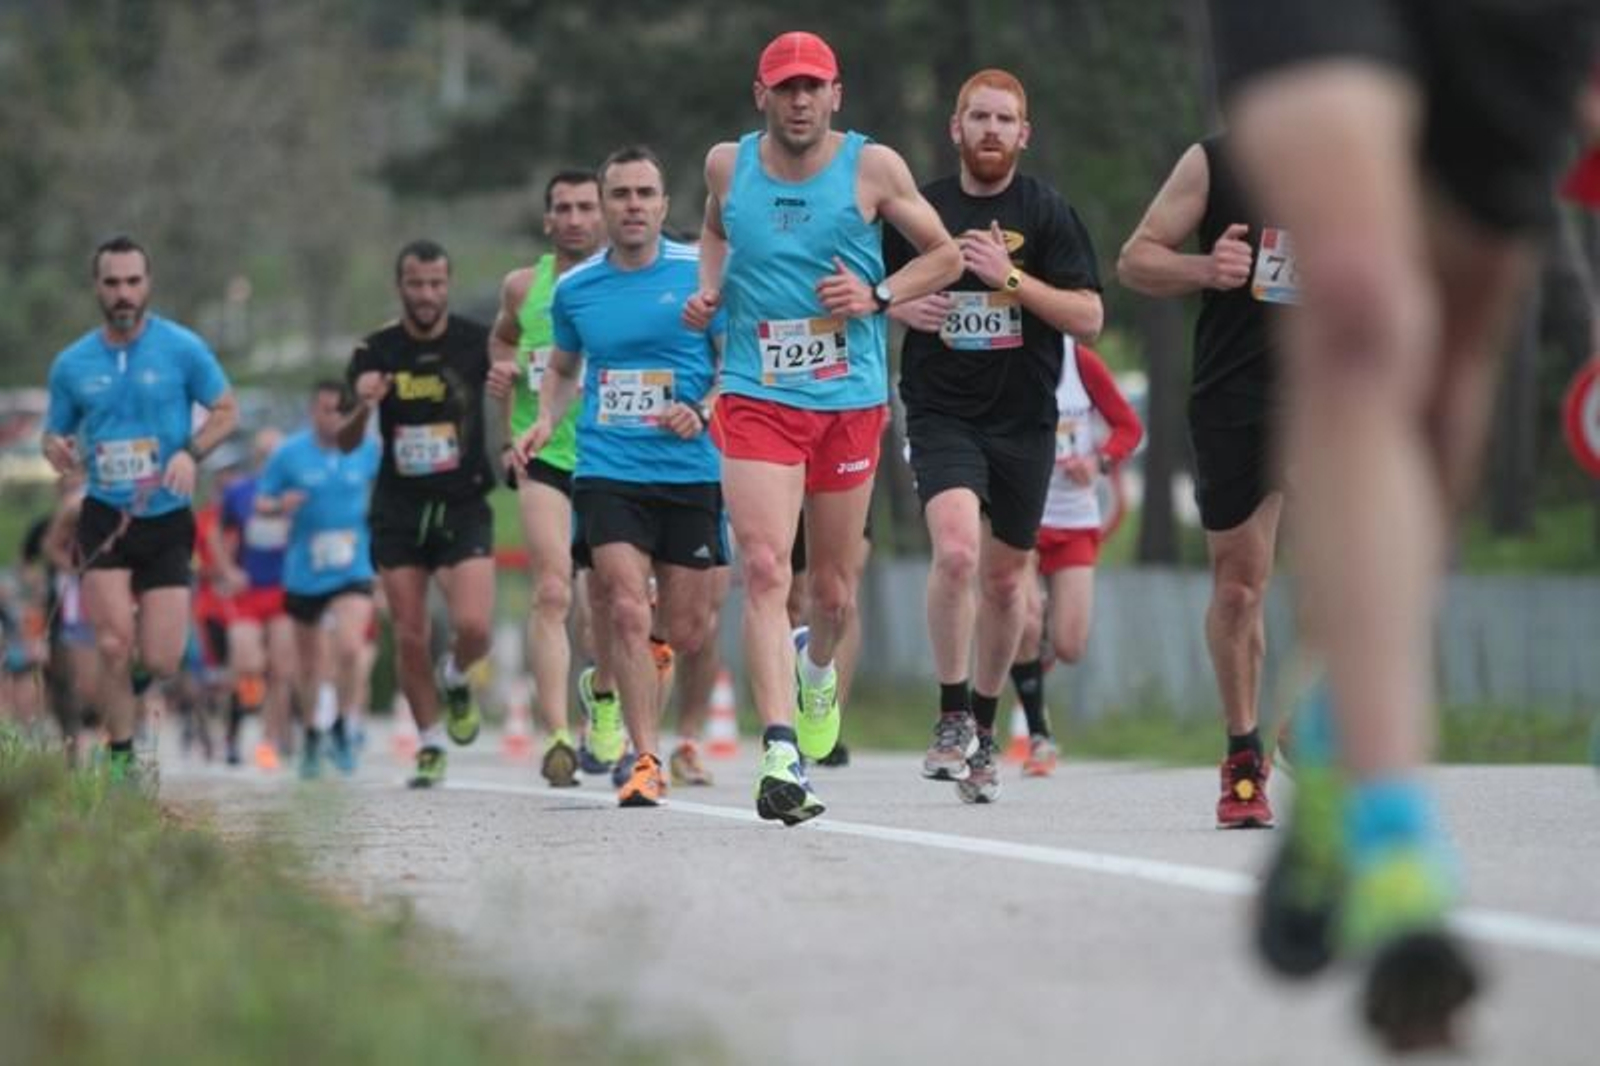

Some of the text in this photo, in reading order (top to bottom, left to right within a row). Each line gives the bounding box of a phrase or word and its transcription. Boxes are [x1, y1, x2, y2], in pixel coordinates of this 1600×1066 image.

[946, 312, 1001, 334] 306
[767, 340, 824, 368] 722
[605, 391, 654, 412] 375
